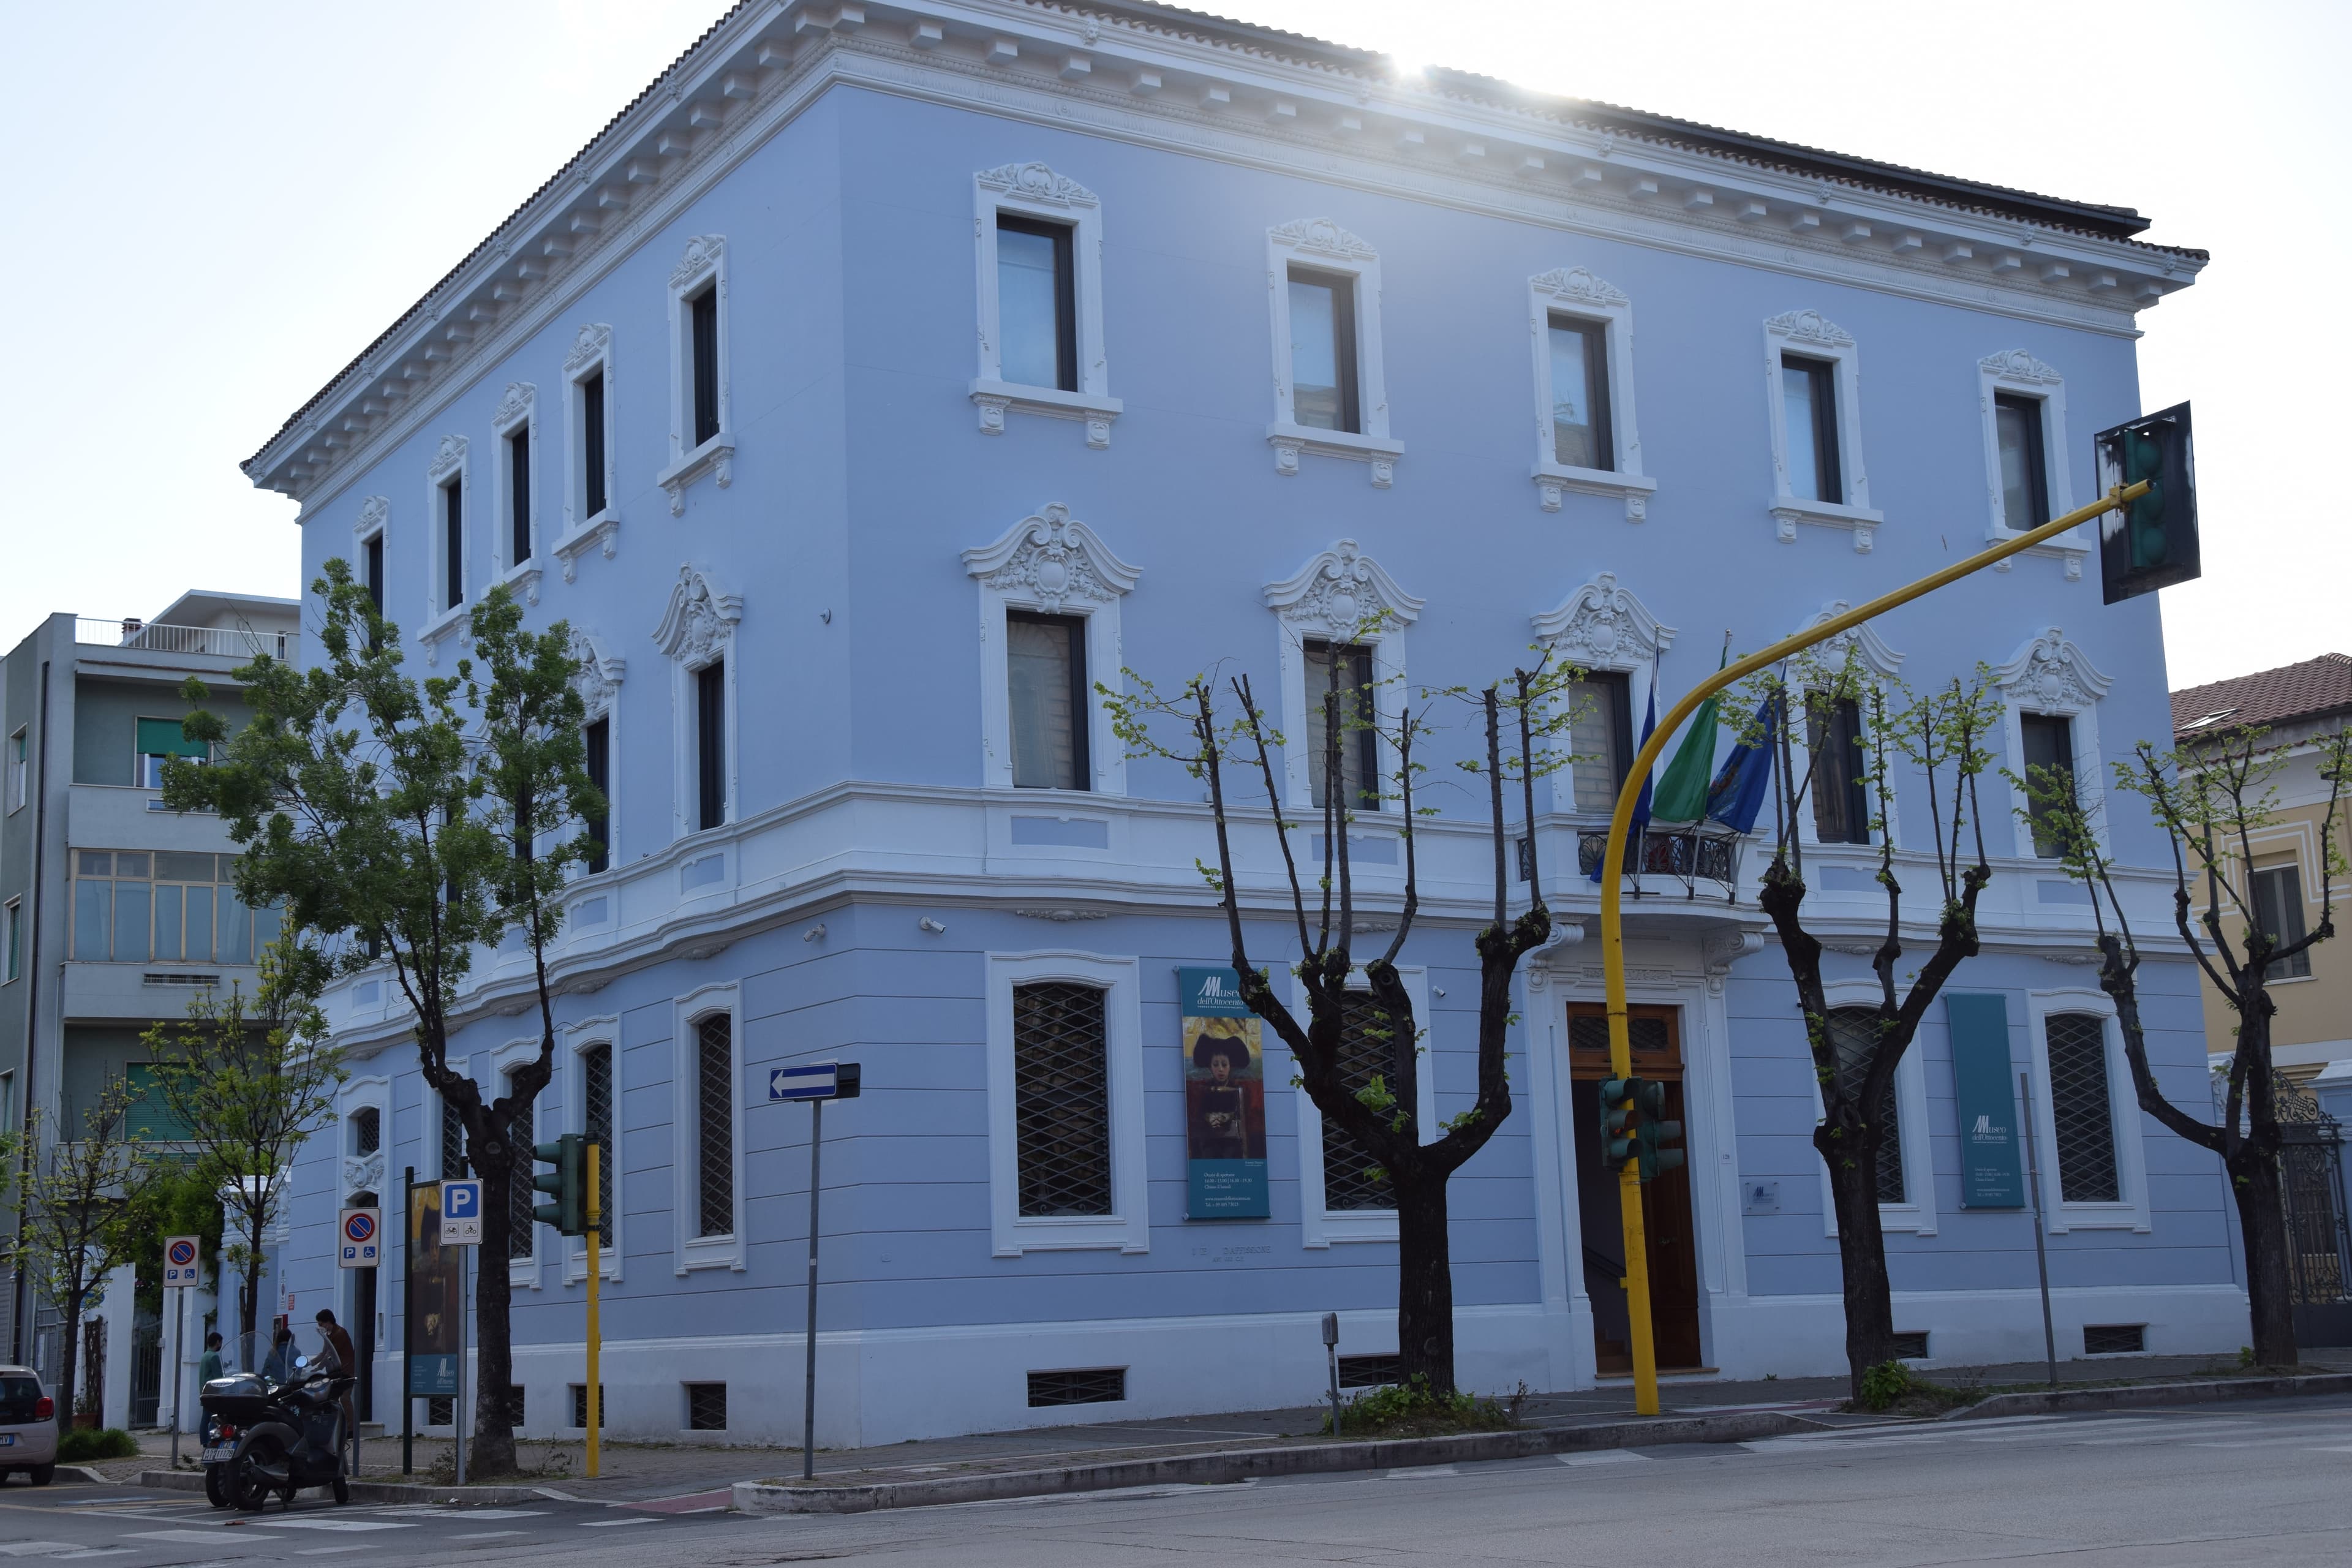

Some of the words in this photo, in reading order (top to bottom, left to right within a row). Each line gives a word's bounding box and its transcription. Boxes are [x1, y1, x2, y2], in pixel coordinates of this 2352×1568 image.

[1197, 997, 1244, 1006] dell'Ottocento
[1972, 1115, 2007, 1133] Museo
[452, 1189, 470, 1213] P
[346, 1248, 353, 1257] P
